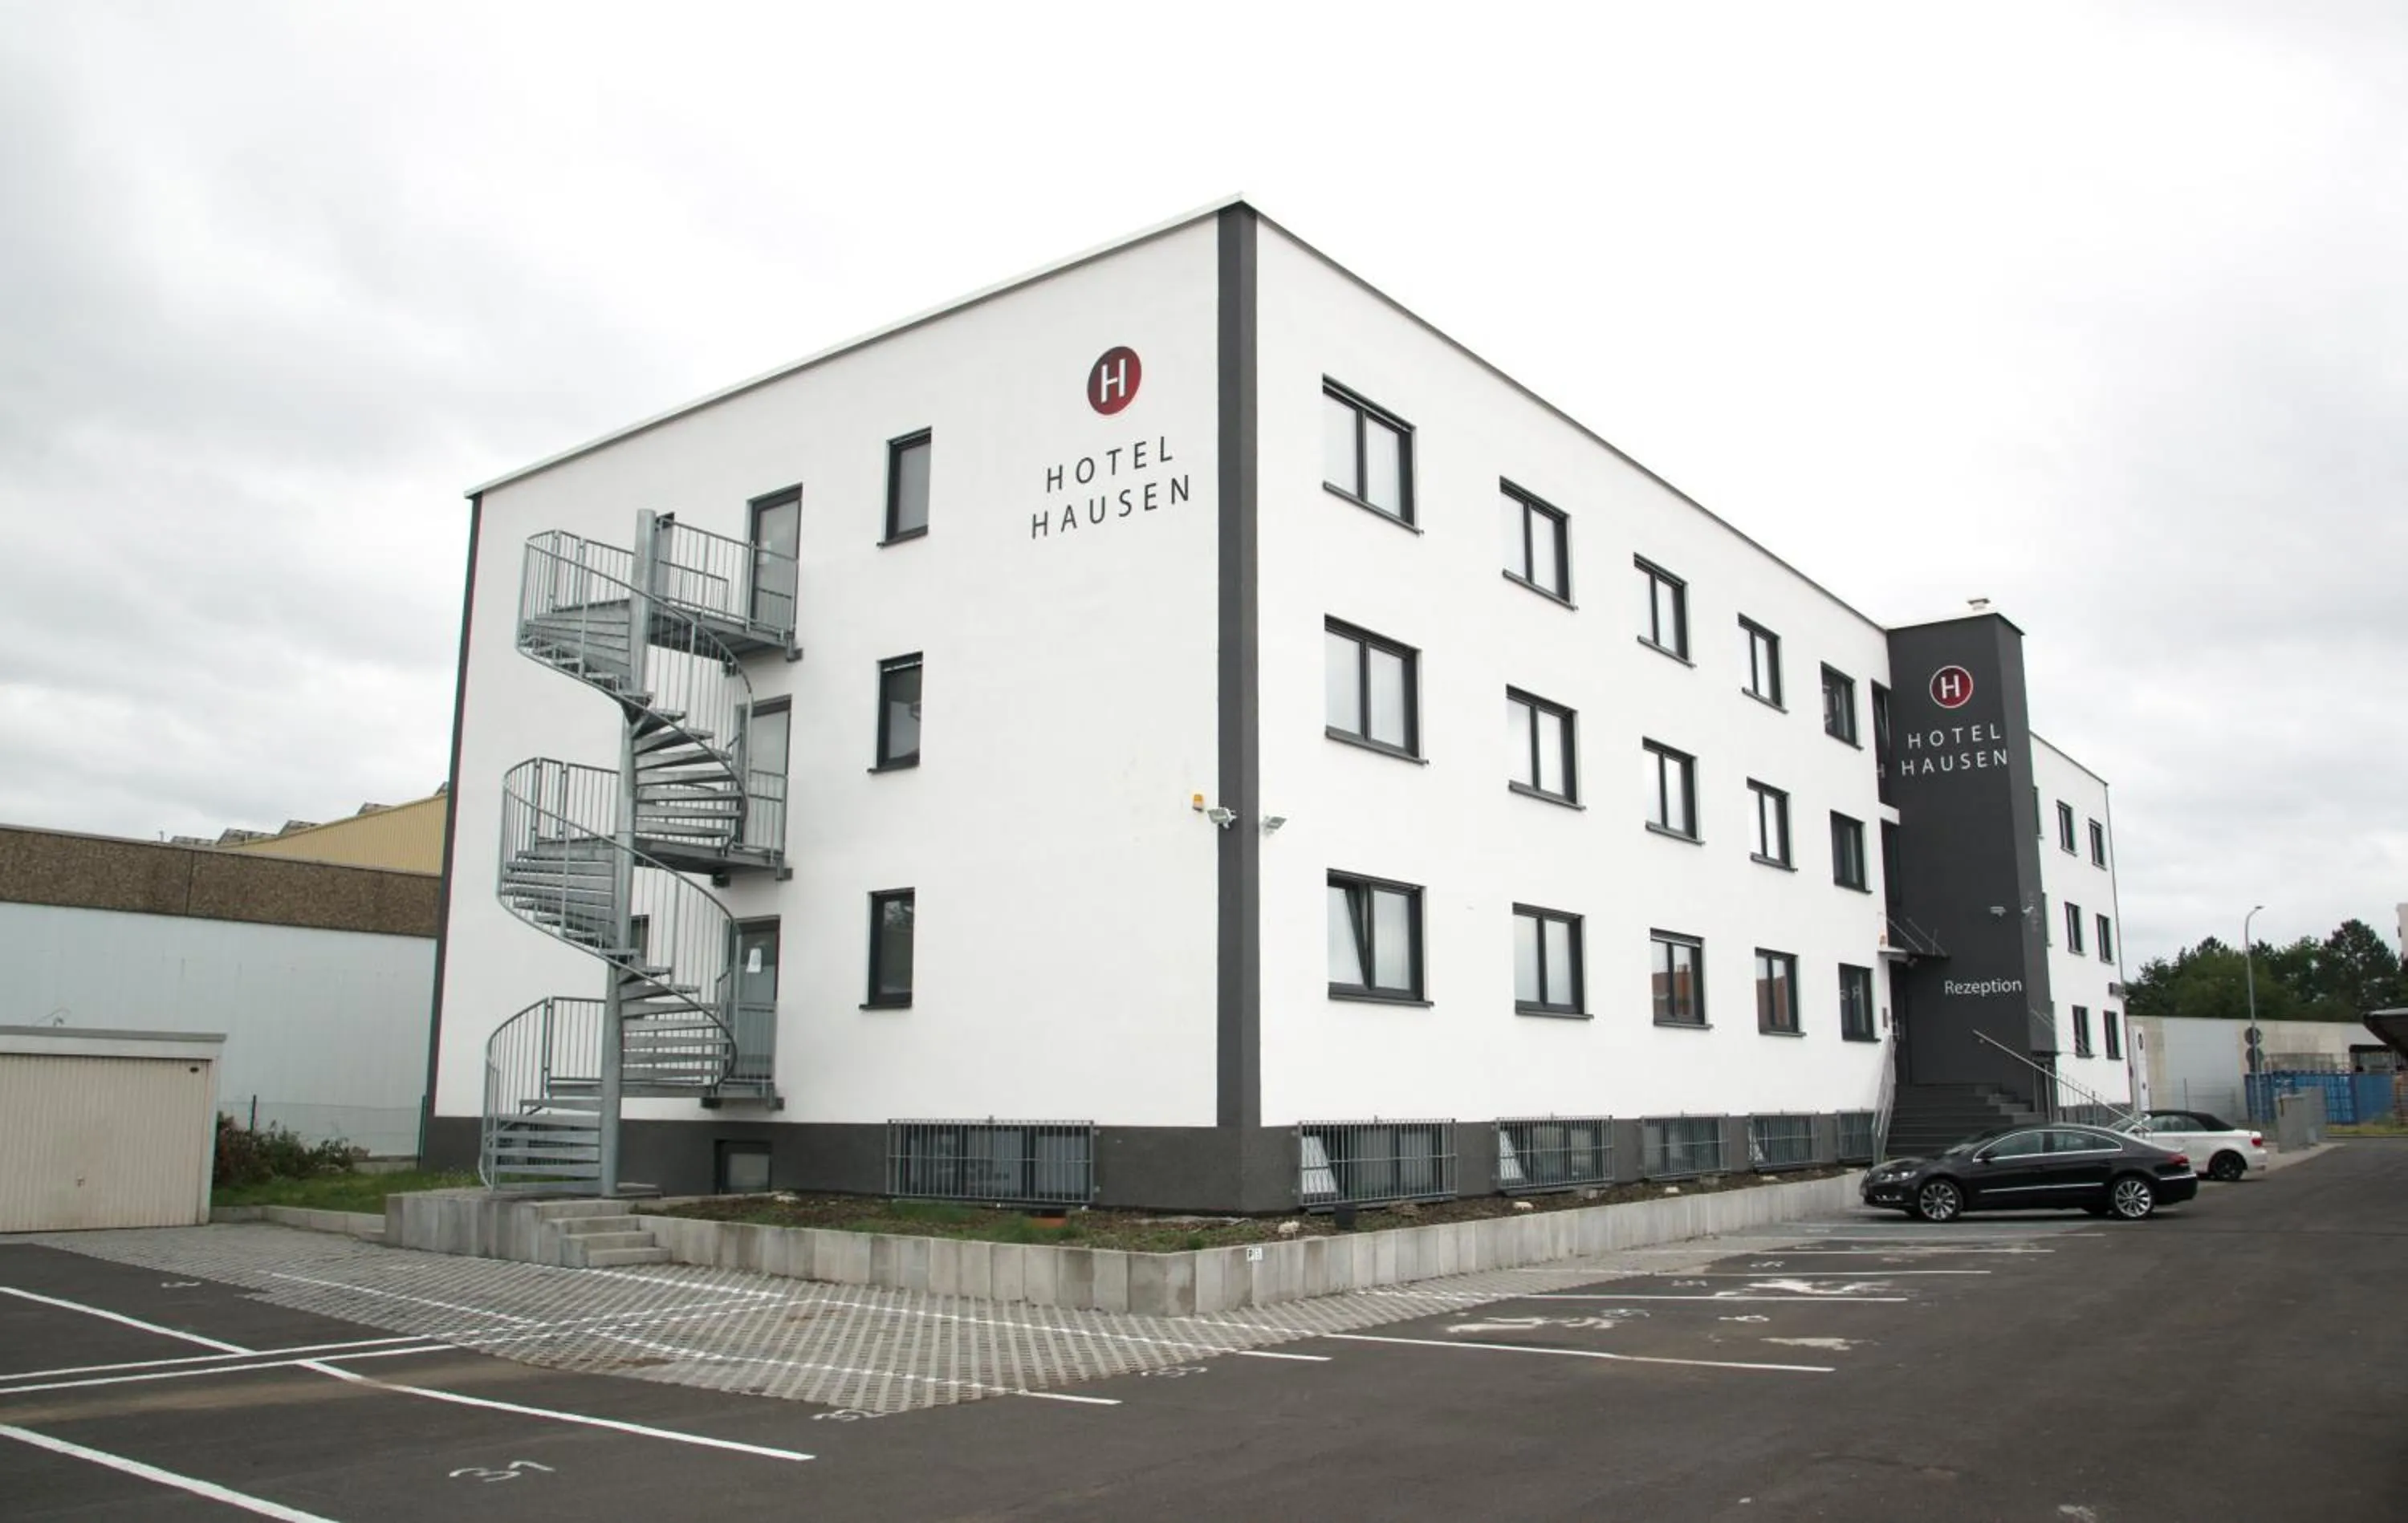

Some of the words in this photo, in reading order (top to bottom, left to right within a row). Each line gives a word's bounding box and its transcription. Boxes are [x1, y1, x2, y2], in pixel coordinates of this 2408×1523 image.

[1100, 359, 1127, 404] H
[1046, 436, 1173, 493] HOTEL
[1031, 474, 1190, 540] HAUSEN
[1940, 674, 1961, 699] H
[1907, 723, 2001, 749] HOTEL
[1901, 749, 2007, 777] HAUSEN
[1944, 978, 2023, 997] Rezeption
